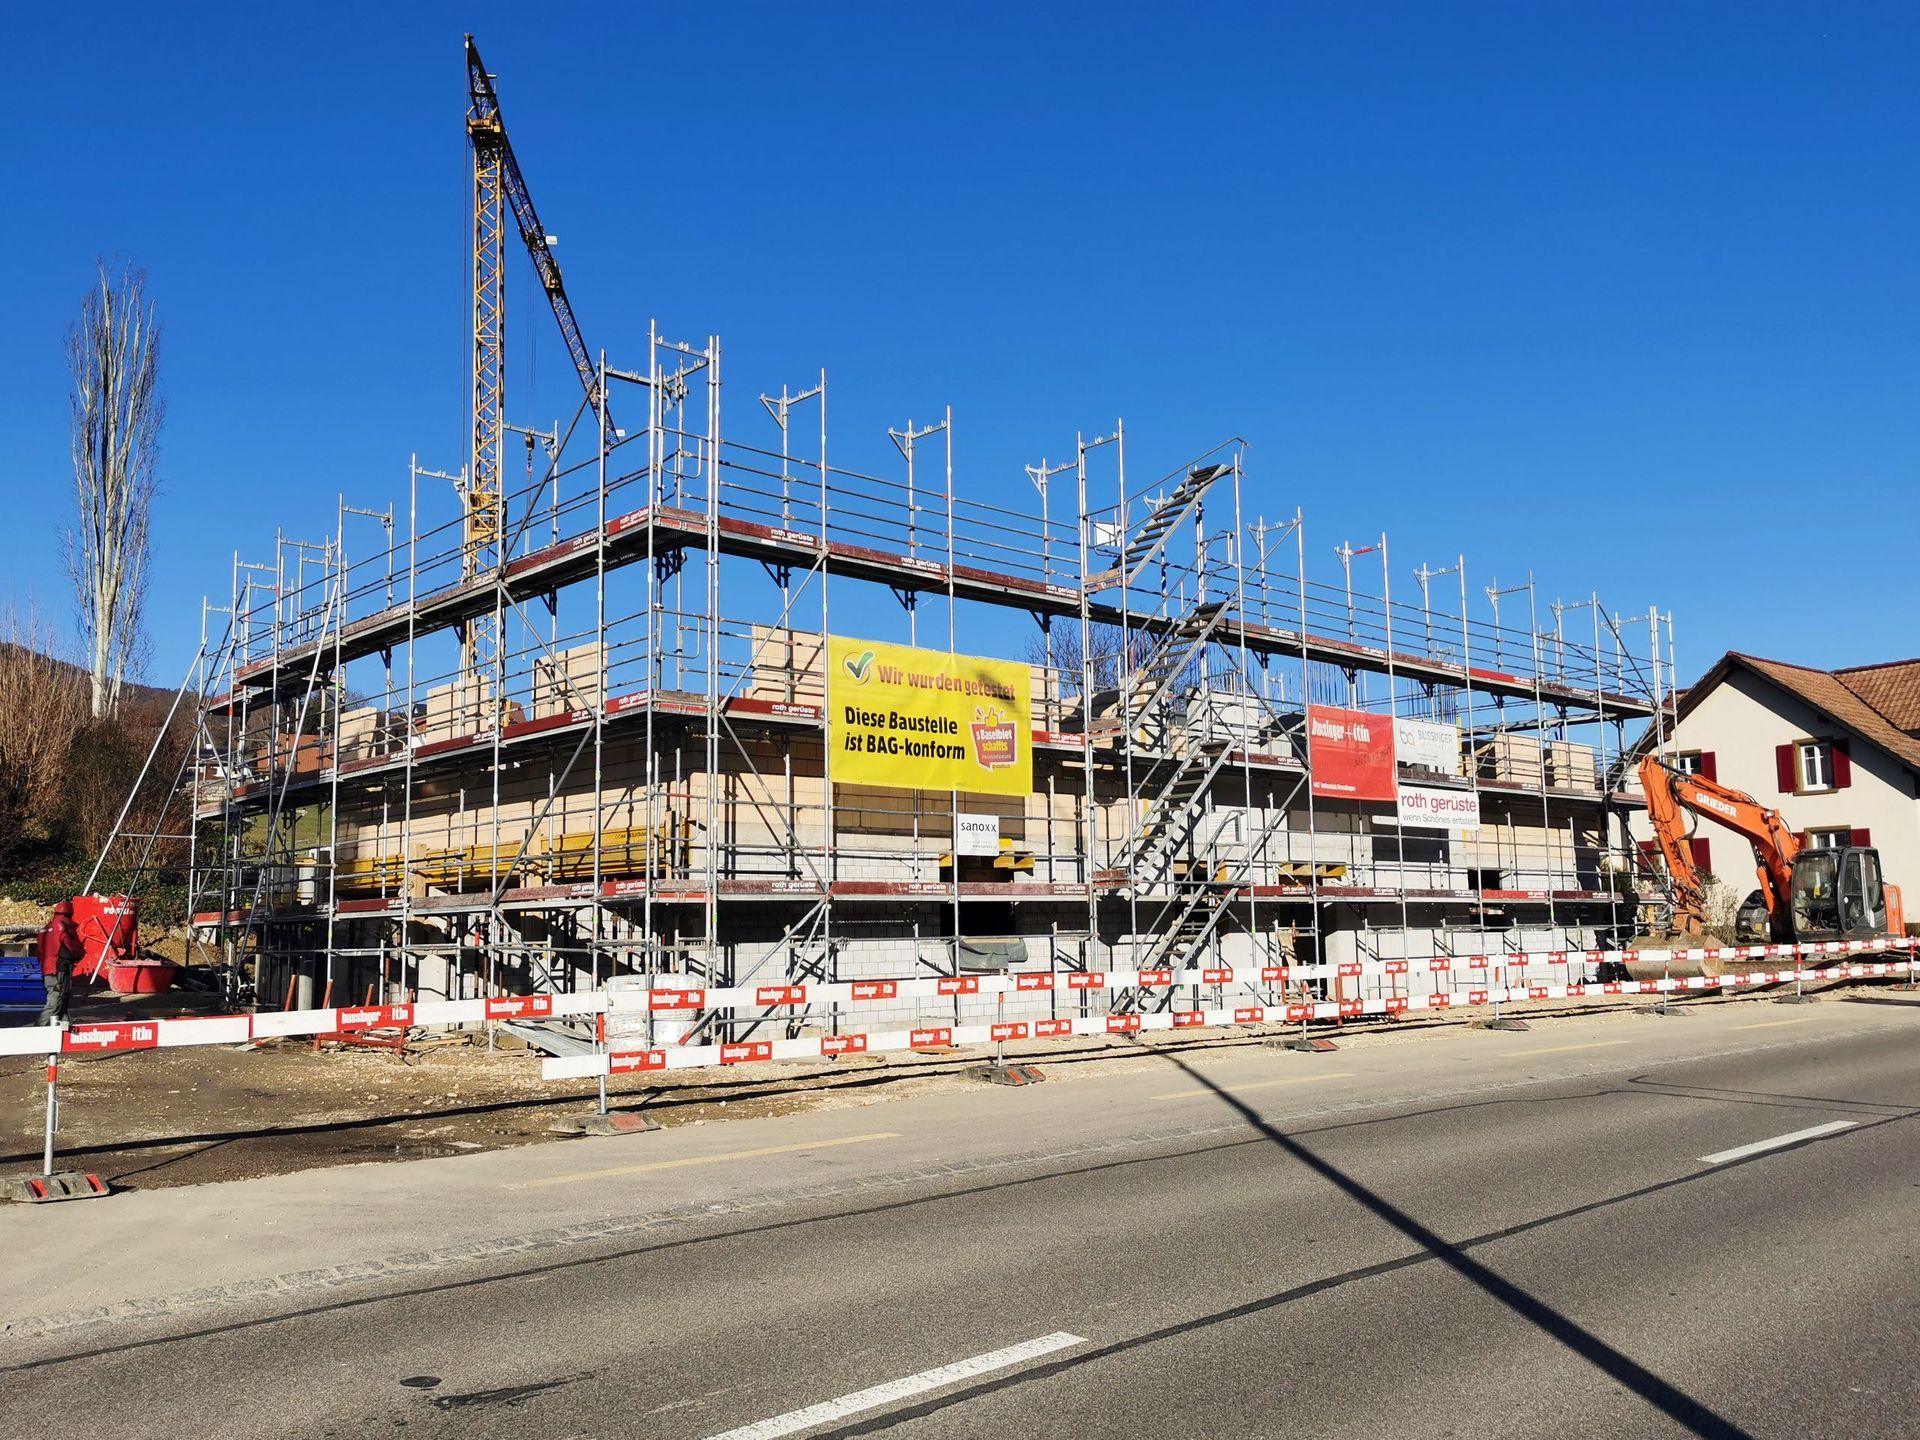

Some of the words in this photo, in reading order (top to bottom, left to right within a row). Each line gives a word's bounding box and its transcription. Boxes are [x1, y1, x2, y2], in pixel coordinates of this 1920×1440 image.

[771, 528, 786, 536] roth
[786, 531, 814, 542] gerüste
[902, 556, 914, 564] roth
[877, 665, 904, 686] Wir
[907, 672, 962, 692] wurden
[964, 680, 1016, 701] getestet
[772, 704, 787, 712] roth
[788, 705, 816, 714] gerüste
[845, 706, 885, 728] Diese
[889, 711, 958, 734] Baustelle
[845, 732, 863, 752] ist
[866, 734, 965, 760] BAG-konform
[1401, 793, 1427, 808] roth
[1430, 796, 1477, 813] gerüste
[1696, 792, 1737, 818] GRIEDER
[1402, 814, 1422, 822] wenn
[960, 822, 996, 832] sanoxx
[616, 882, 626, 890] roth
[788, 881, 816, 890] gerüste
[341, 1010, 382, 1026] bussinger
[391, 1007, 408, 1020] itin
[70, 1028, 118, 1046] bussinger
[131, 1026, 152, 1041] itin
